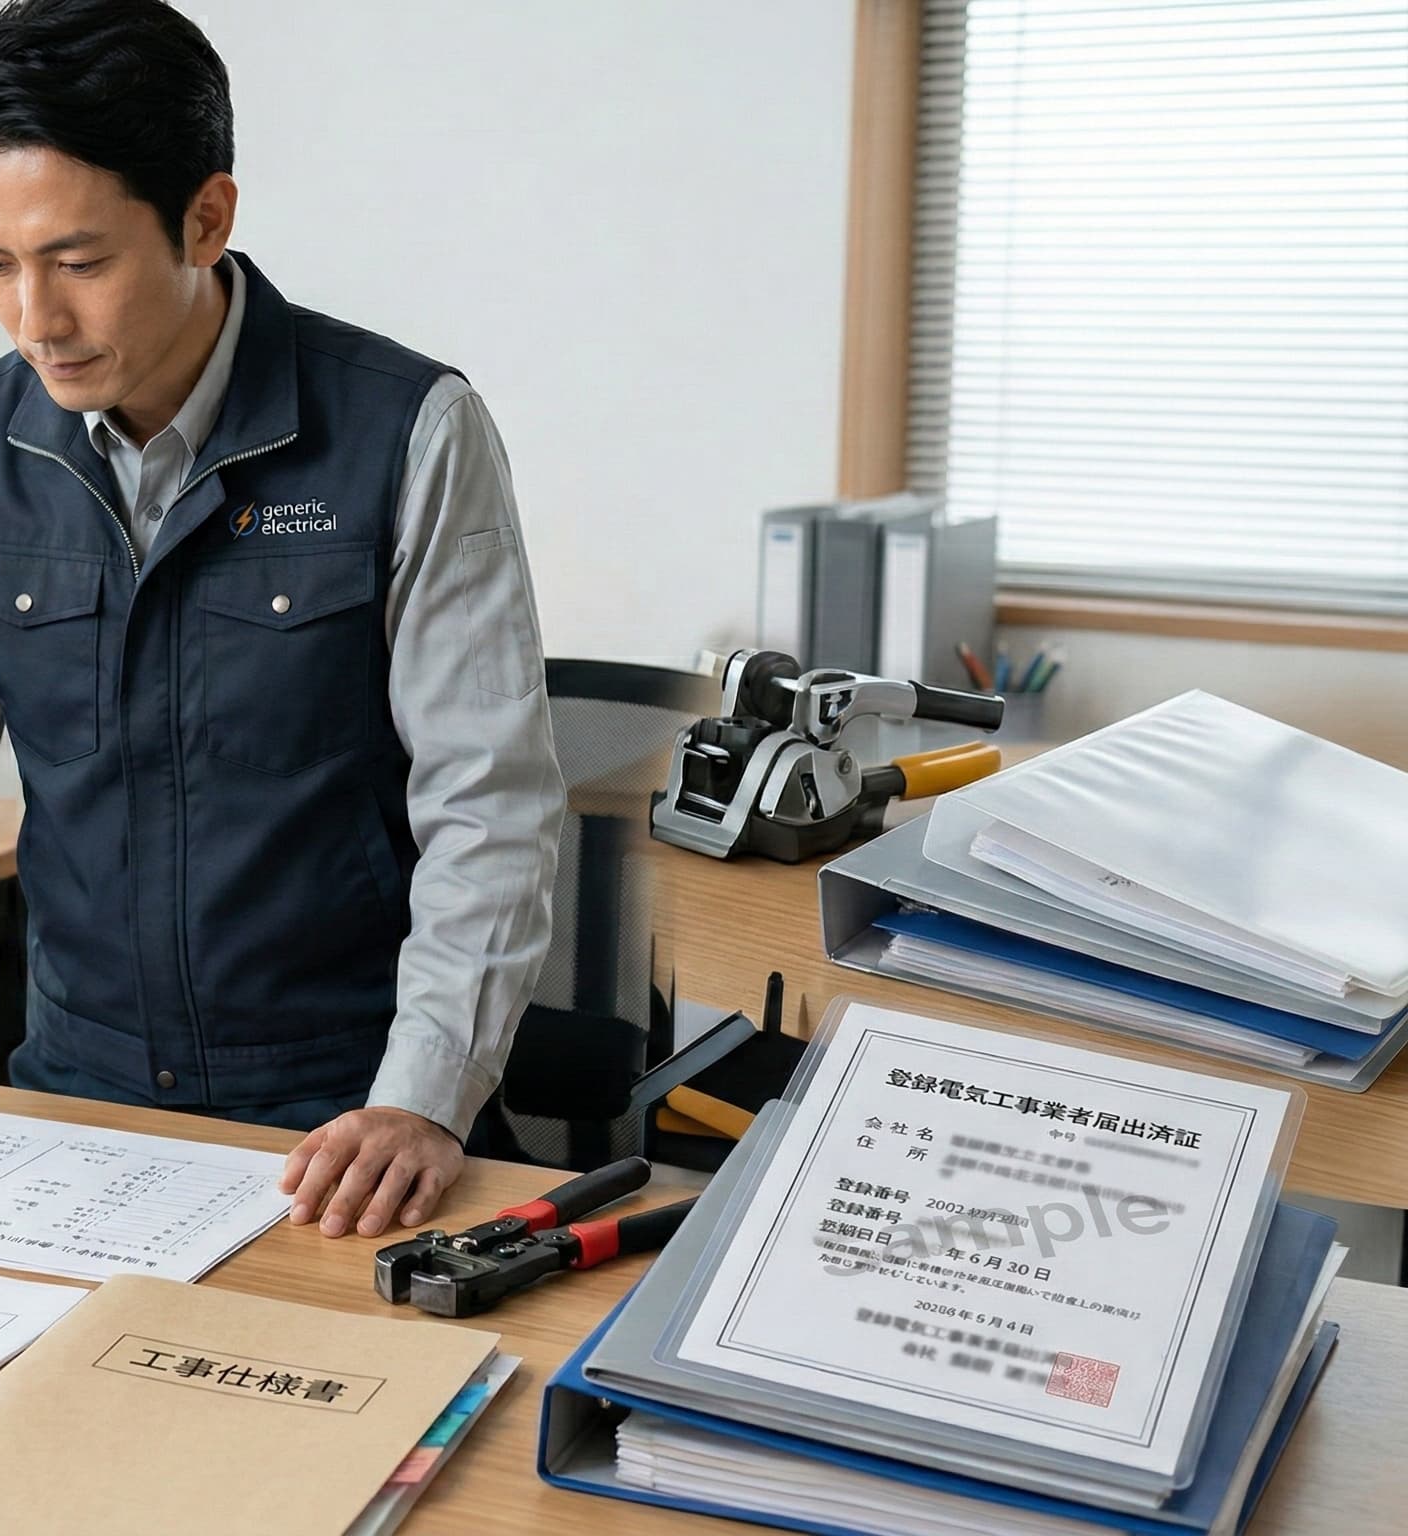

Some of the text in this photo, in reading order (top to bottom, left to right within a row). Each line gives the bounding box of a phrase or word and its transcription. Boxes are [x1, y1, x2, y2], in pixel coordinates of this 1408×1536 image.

[261, 514, 337, 535] electrical
[262, 499, 327, 521] generic
[885, 1067, 1202, 1150] 登録電気工事業者届出済証
[128, 1347, 350, 1404] 工事仕様書
